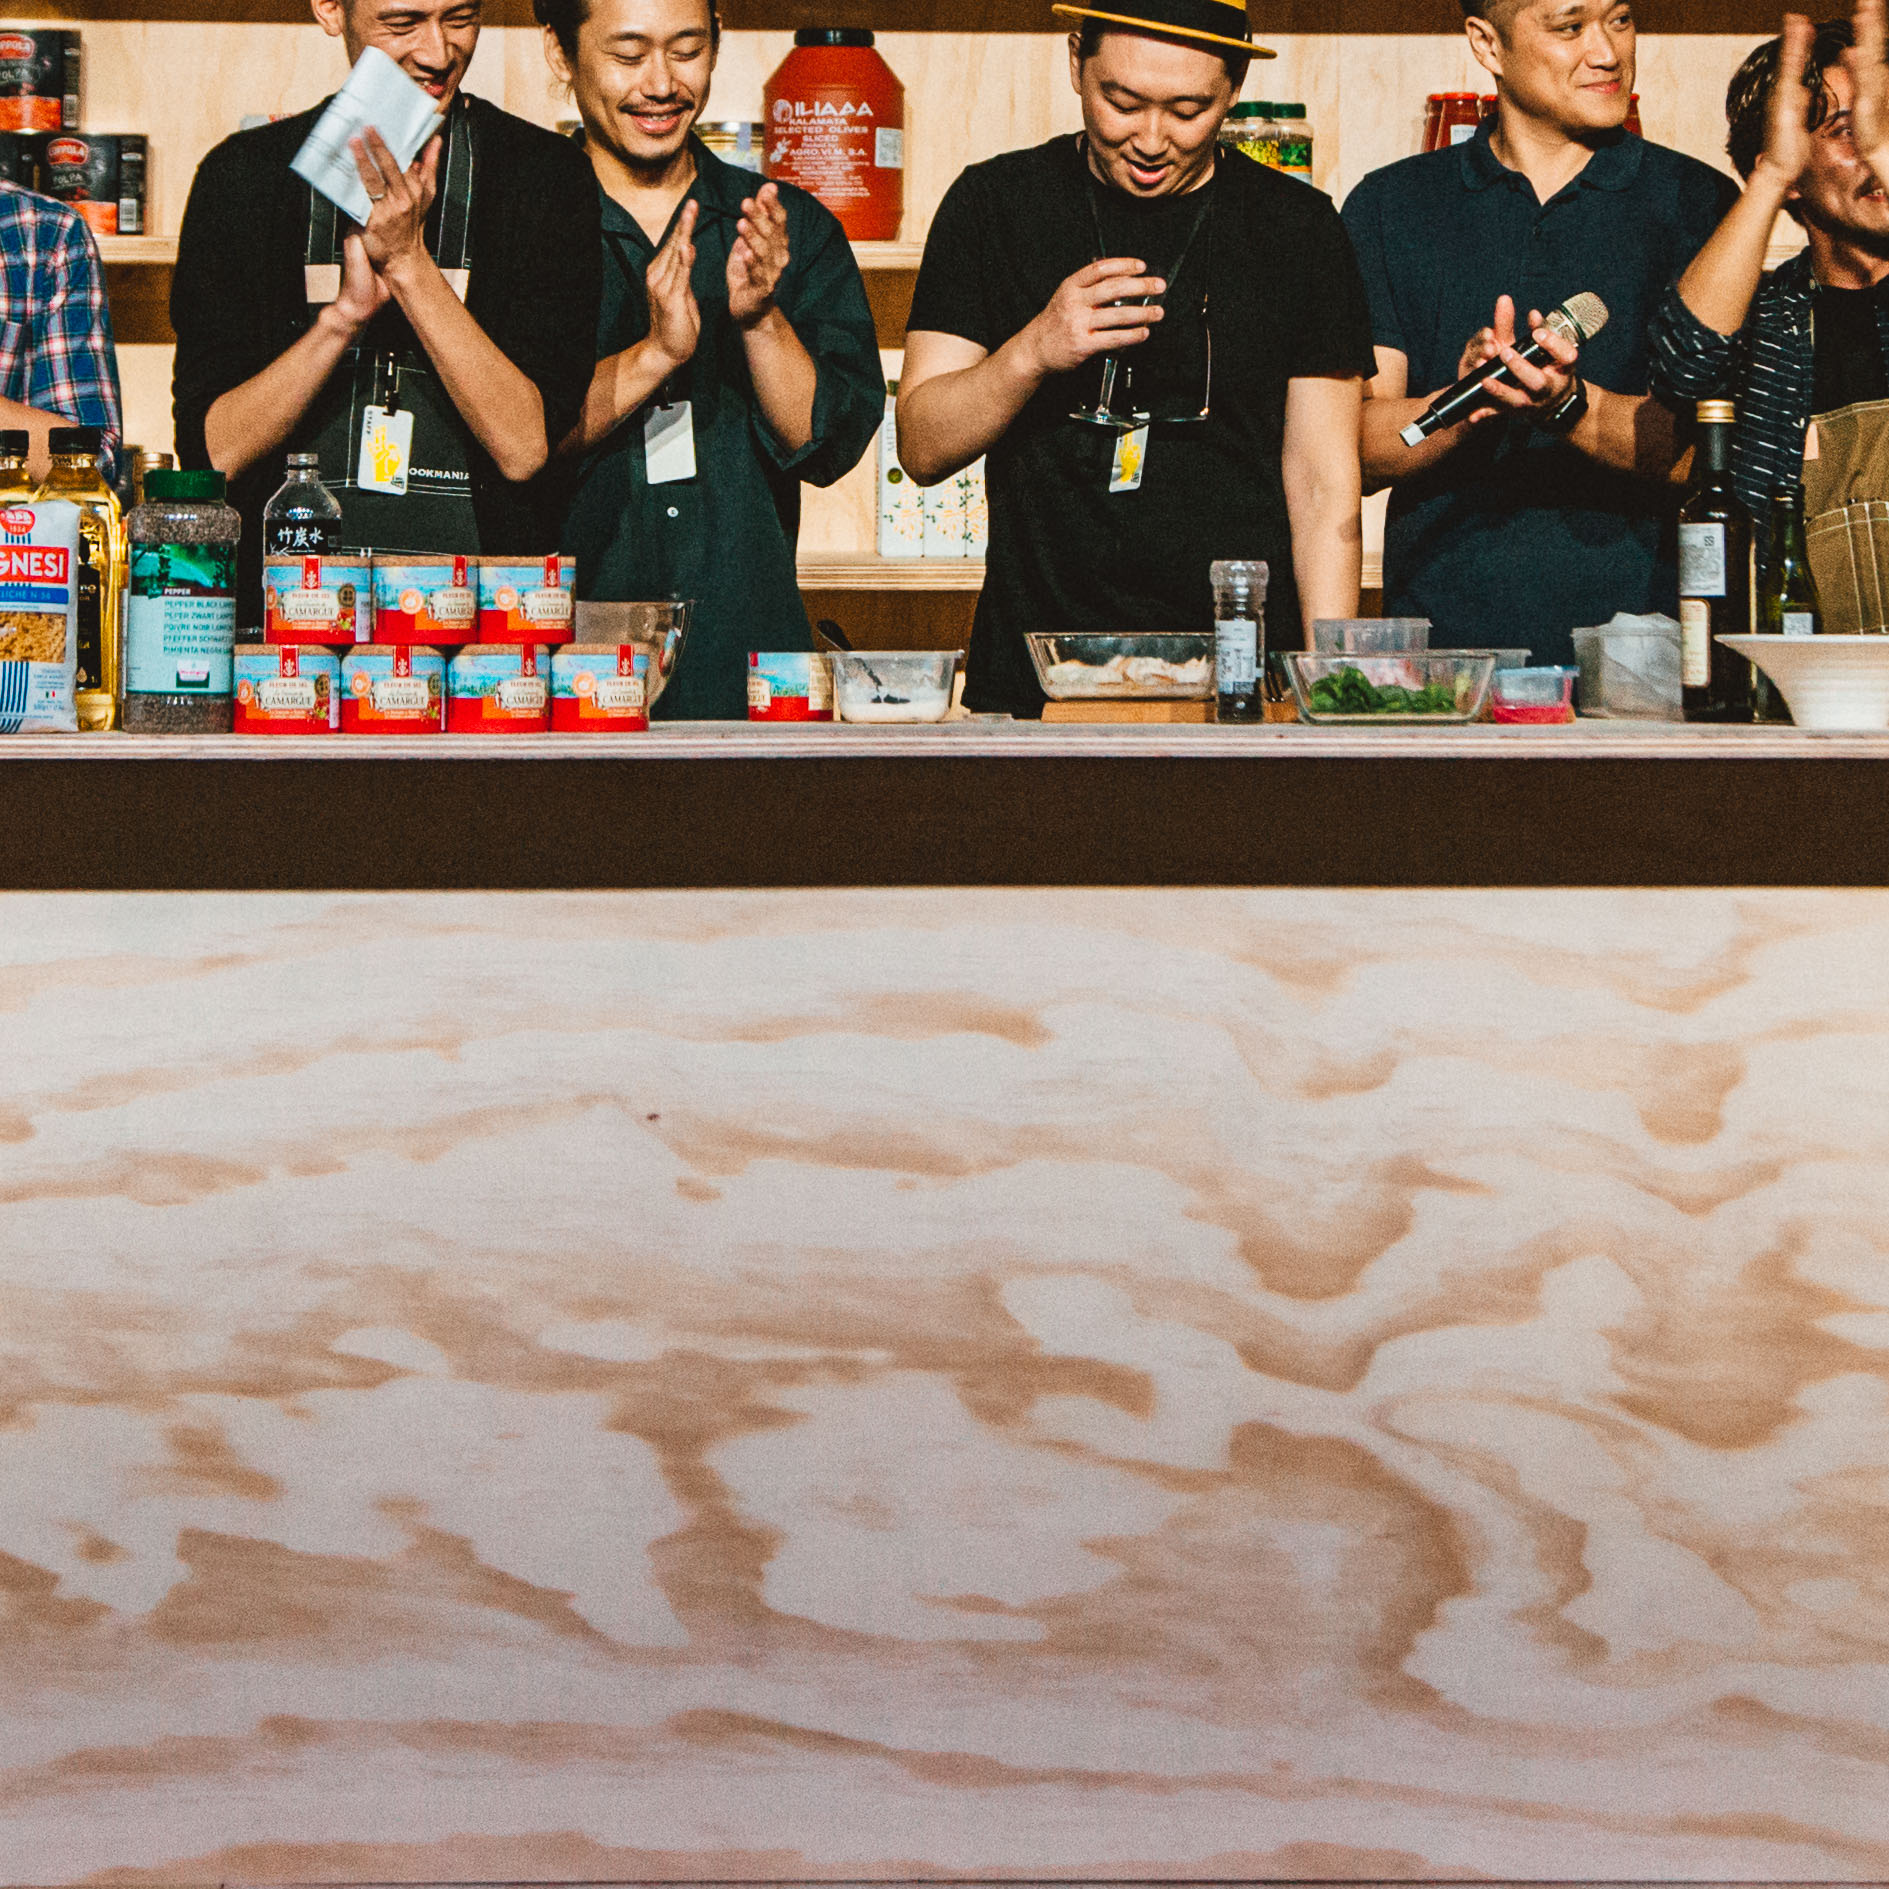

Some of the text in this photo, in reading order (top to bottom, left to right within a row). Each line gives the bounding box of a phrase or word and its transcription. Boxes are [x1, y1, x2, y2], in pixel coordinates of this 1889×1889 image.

[408, 467, 470, 480] OOKMANIA
[277, 526, 324, 548] 竹炭水
